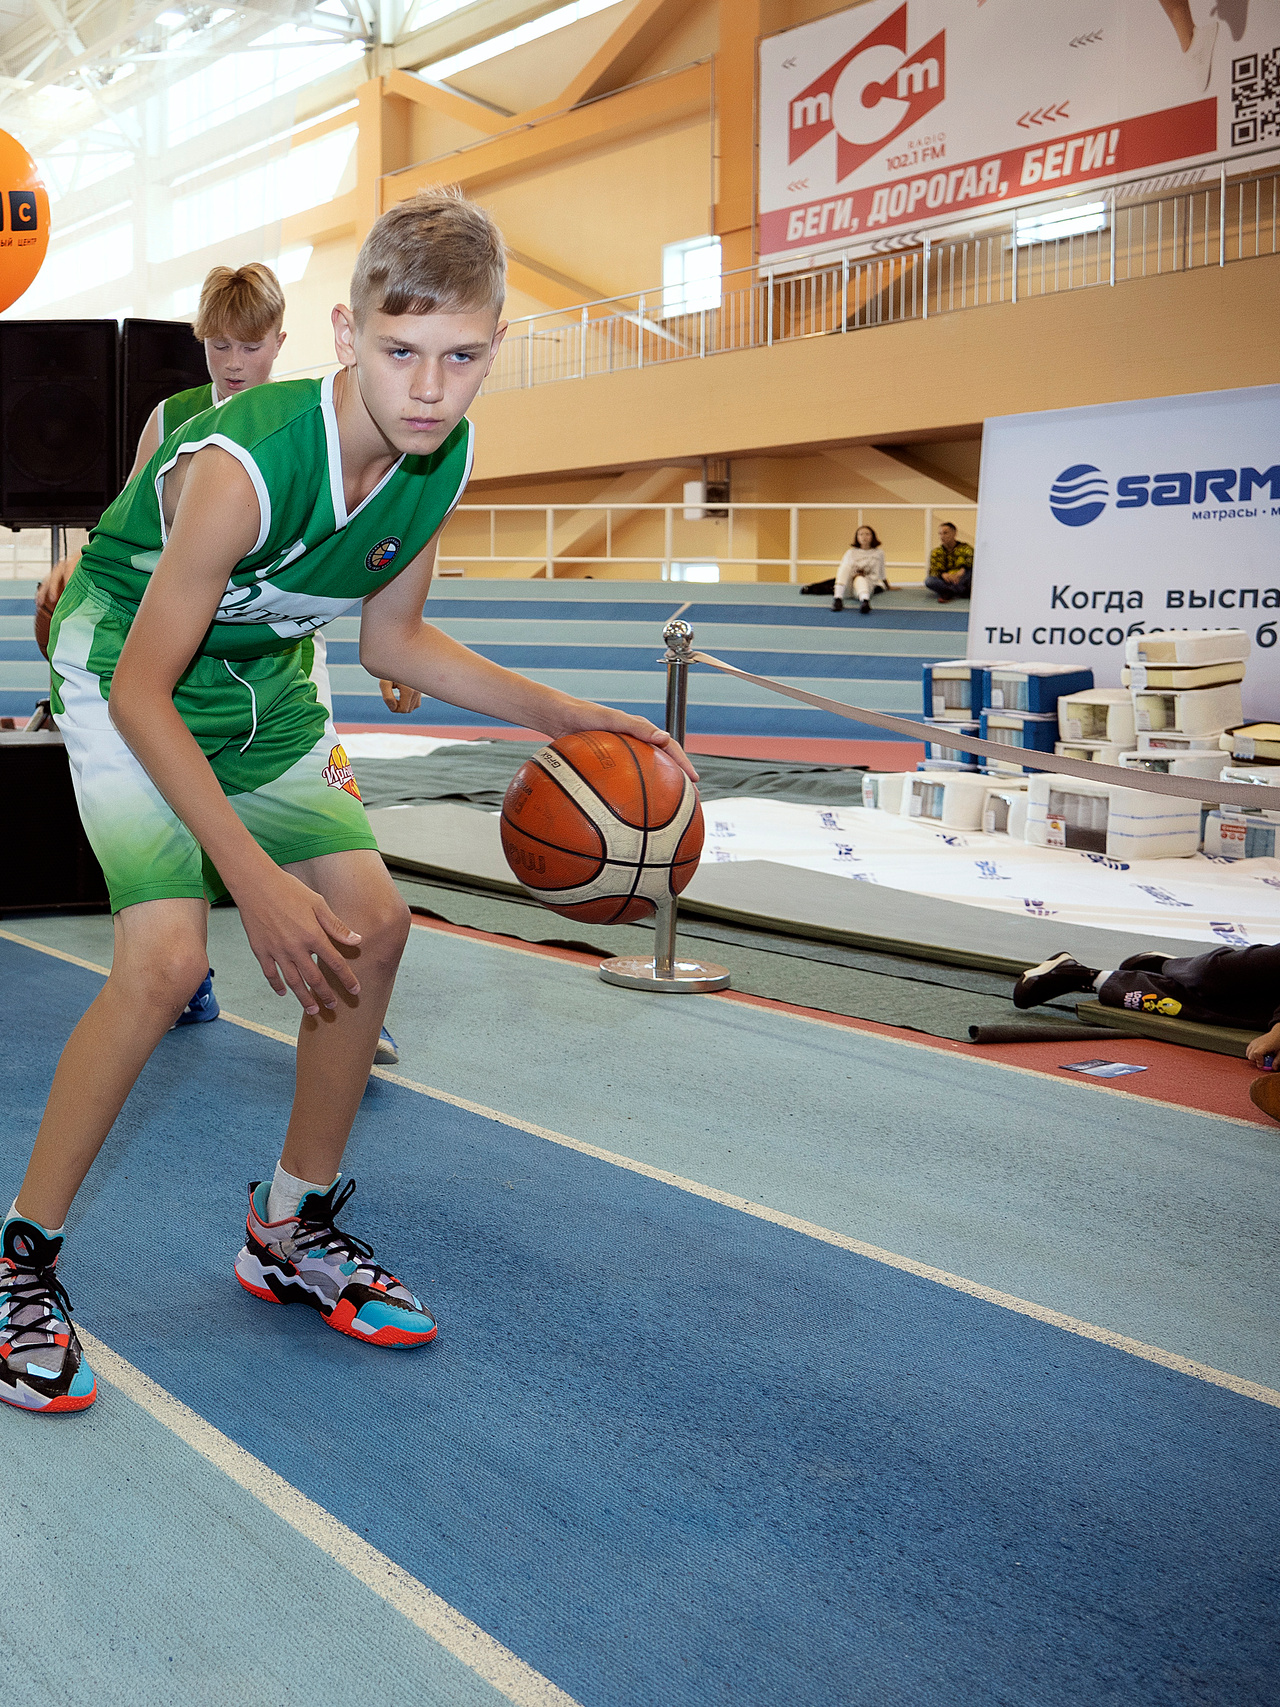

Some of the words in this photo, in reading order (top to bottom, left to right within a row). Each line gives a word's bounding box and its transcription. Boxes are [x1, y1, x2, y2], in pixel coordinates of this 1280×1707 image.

[907, 132, 947, 149] RADIO
[885, 149, 919, 171] 102.1
[921, 143, 946, 162] FM
[786, 197, 860, 242] БЕГИ,
[866, 158, 1010, 228] ДОРОГАЯ,
[1019, 128, 1120, 187] БЕГИ!
[1192, 508, 1257, 521] матрасы
[1051, 585, 1144, 613] Когда
[985, 627, 1021, 645] ты
